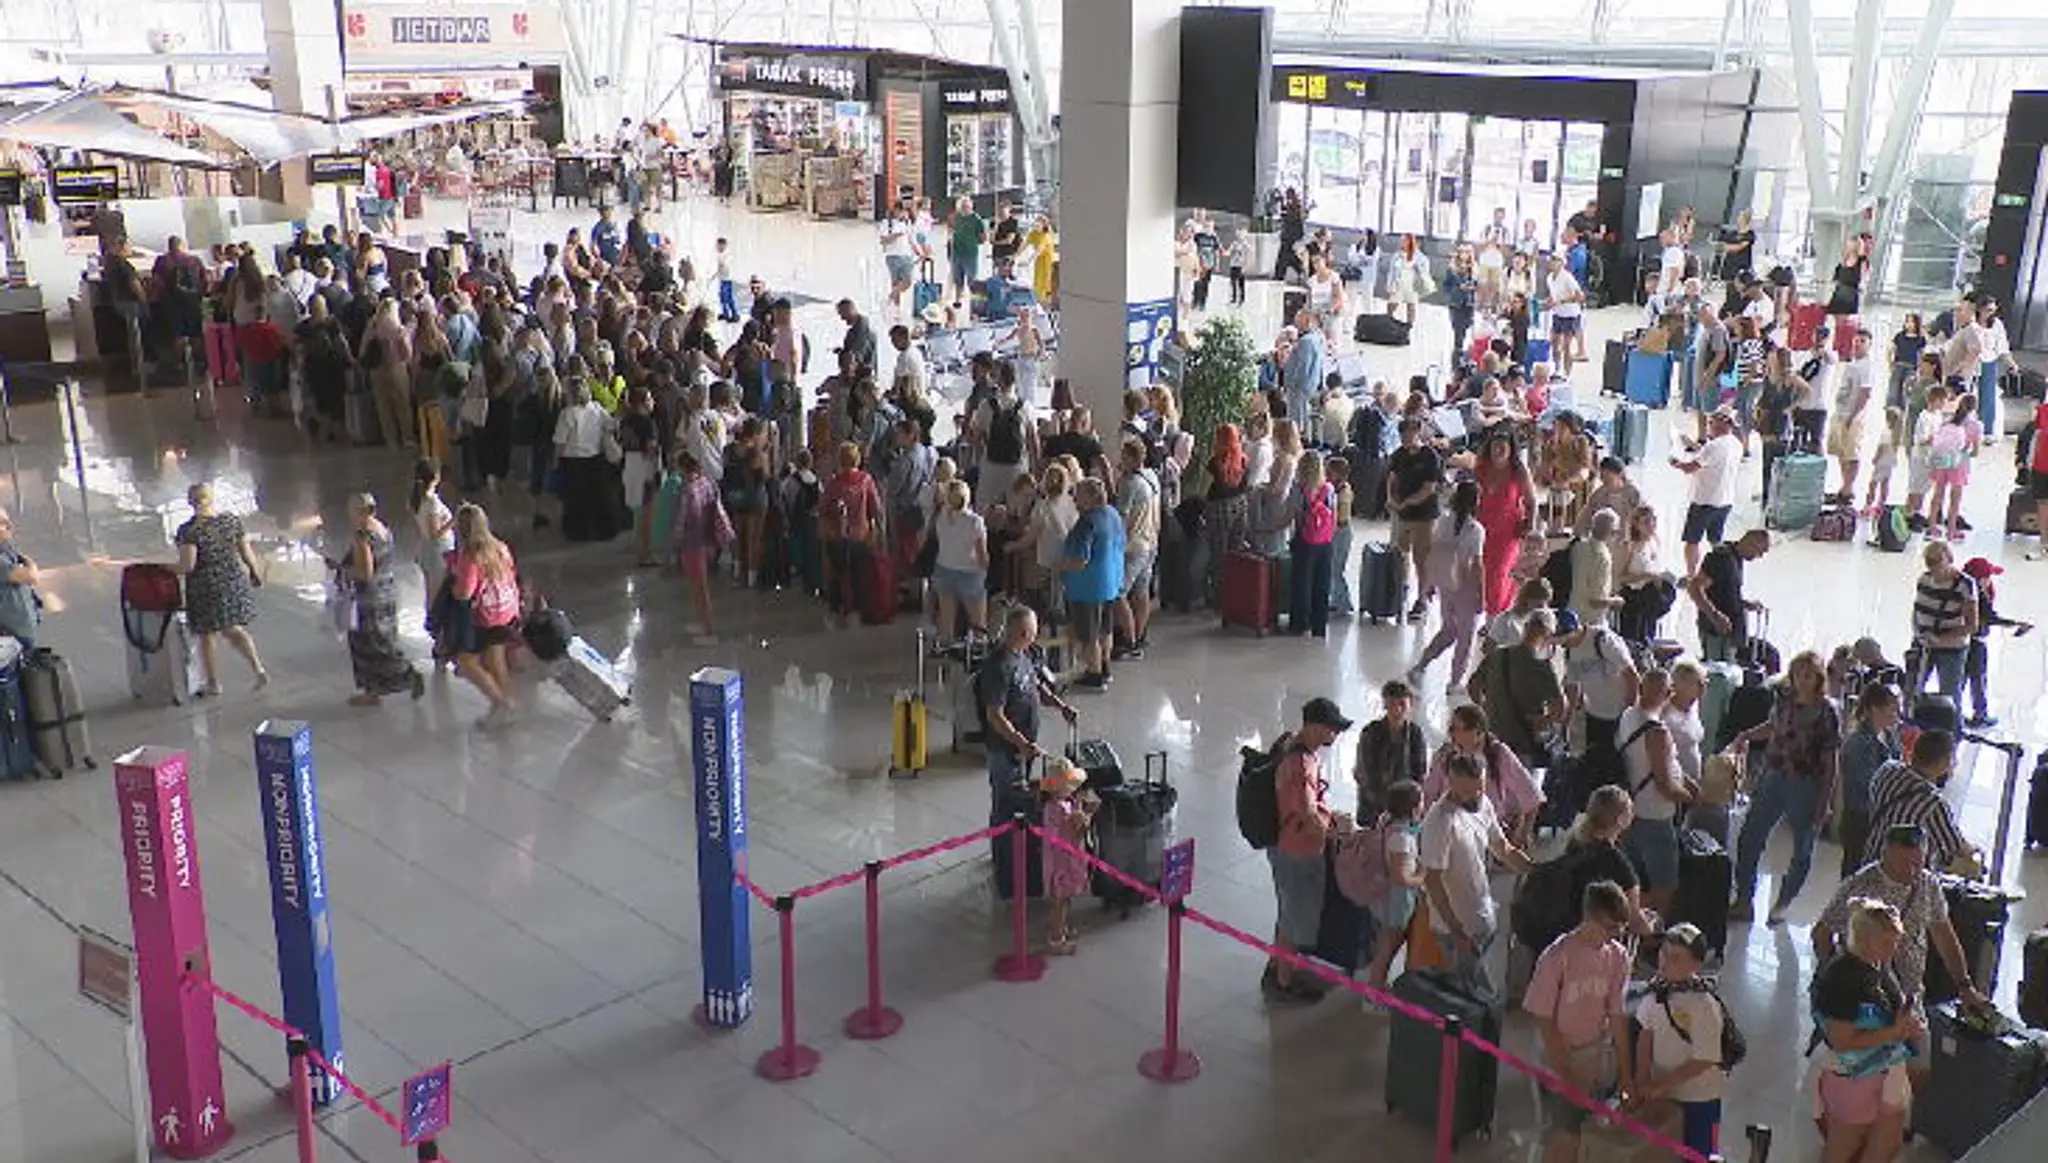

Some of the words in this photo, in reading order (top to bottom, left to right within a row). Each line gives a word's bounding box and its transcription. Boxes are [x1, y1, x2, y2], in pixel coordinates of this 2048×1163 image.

[809, 66, 856, 92] PRESS
[131, 801, 156, 898] PRIORITY
[169, 795, 191, 888] PRIORITY
